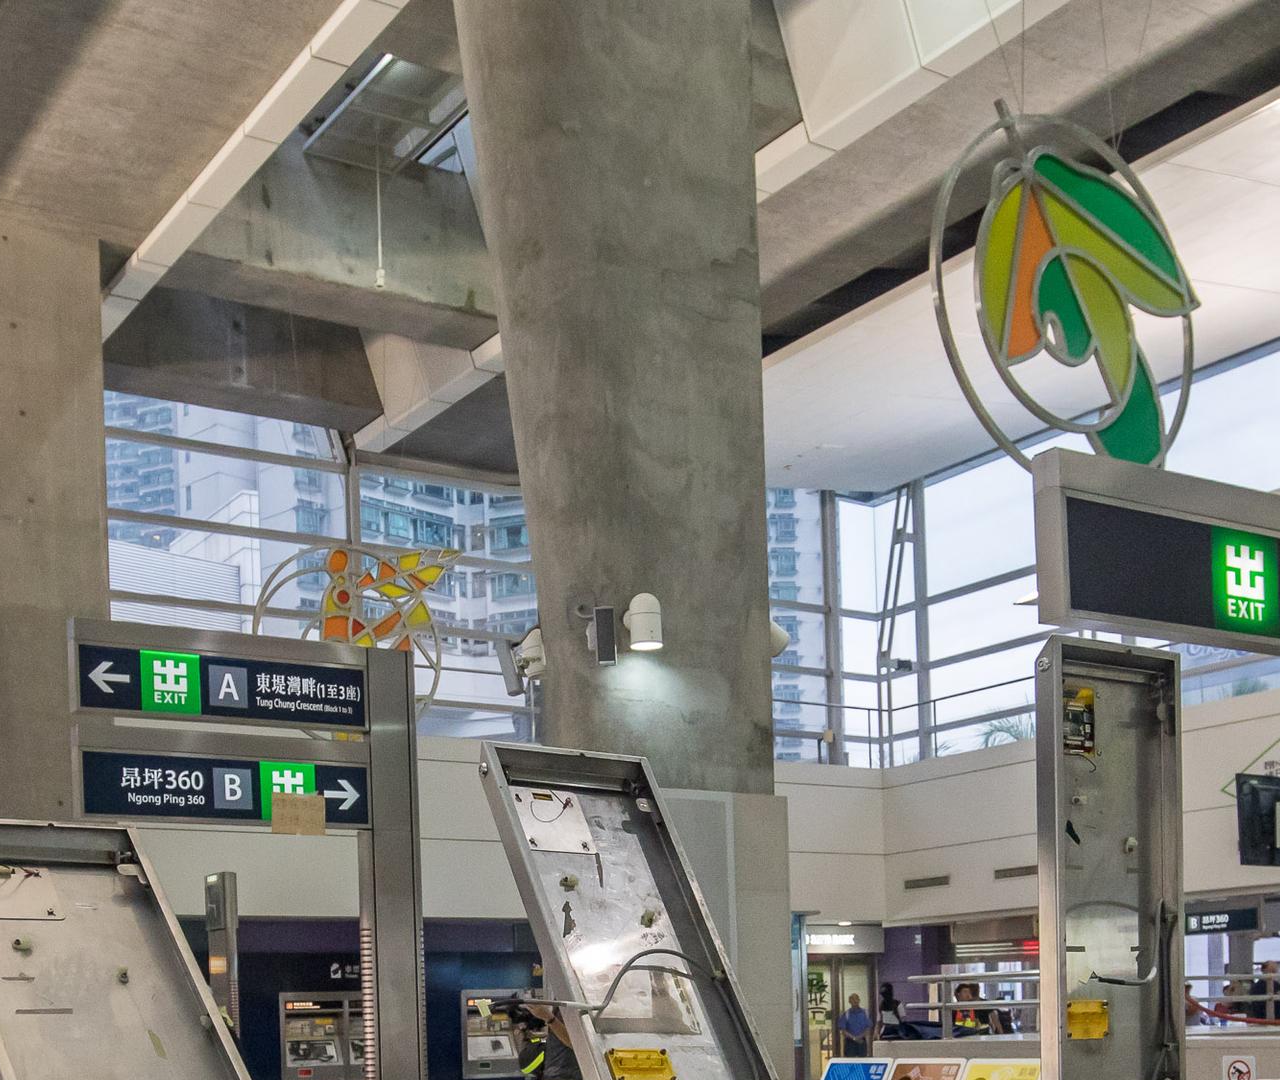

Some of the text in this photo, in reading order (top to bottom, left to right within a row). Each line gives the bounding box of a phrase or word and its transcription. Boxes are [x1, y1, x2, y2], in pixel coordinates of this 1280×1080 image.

[1226, 545, 1265, 600] 出
[1227, 598, 1265, 621] EXIT
[153, 660, 188, 692] 出
[218, 673, 240, 701] A
[256, 673, 361, 702] 東堤灣畔(1至3座)
[154, 691, 188, 705] EXIT
[256, 697, 273, 710] Tung
[274, 698, 295, 712] Chung
[296, 700, 323, 712] Crescent
[121, 767, 205, 791] 昂坪360
[224, 774, 243, 801] B
[128, 792, 206, 807] Ngong Ping 360
